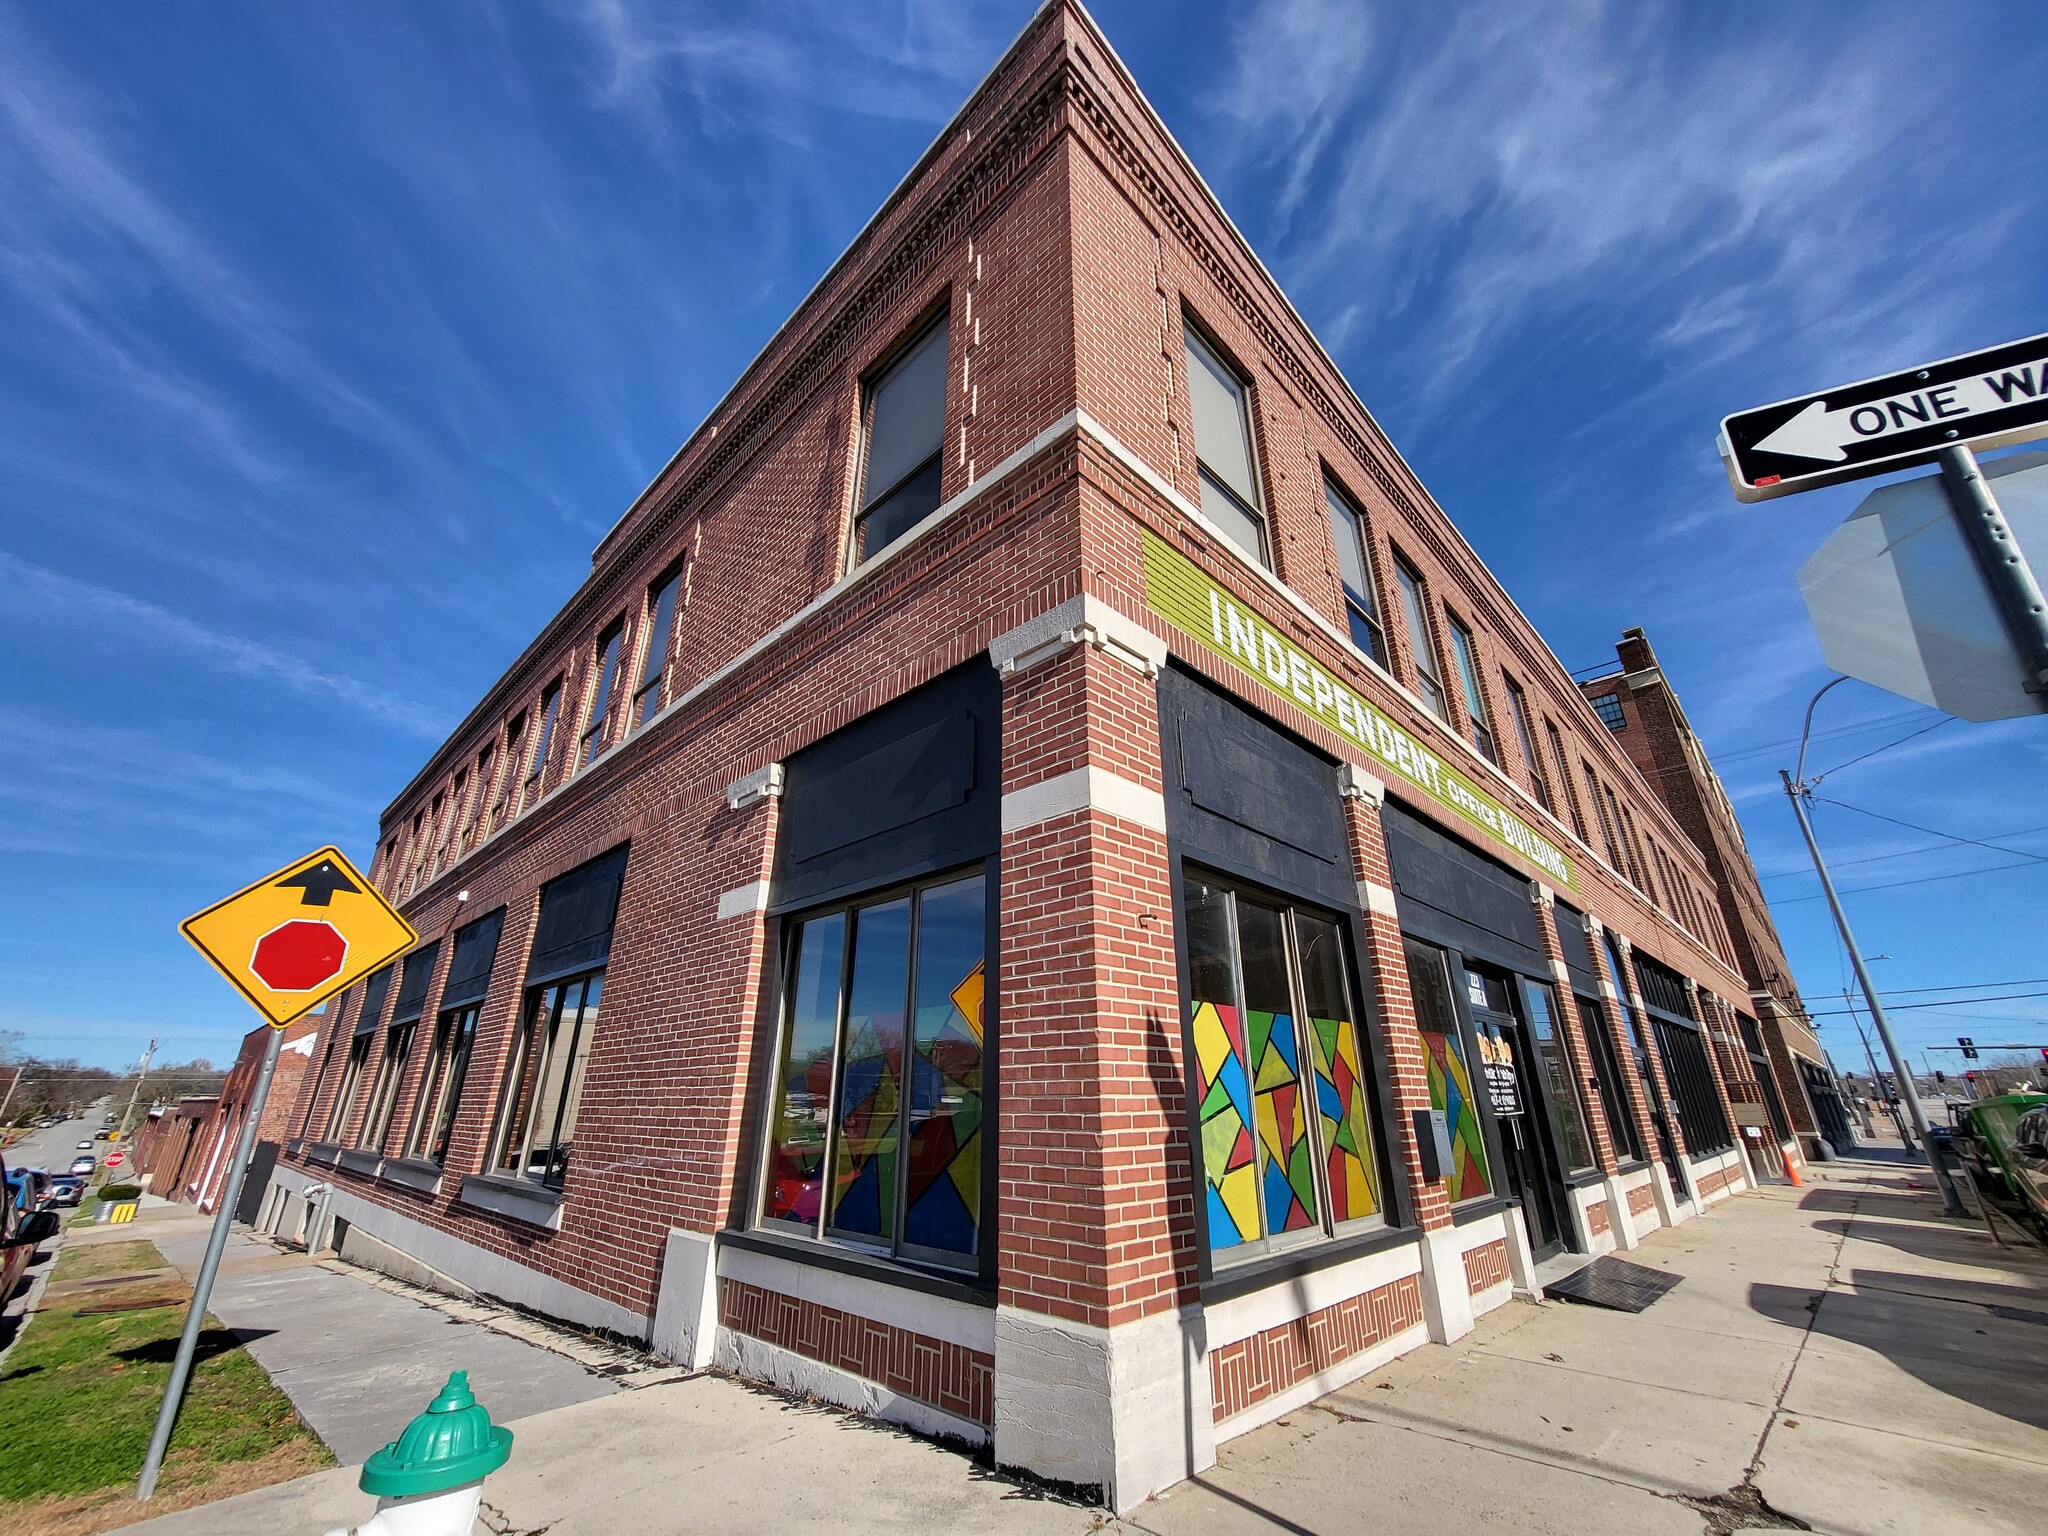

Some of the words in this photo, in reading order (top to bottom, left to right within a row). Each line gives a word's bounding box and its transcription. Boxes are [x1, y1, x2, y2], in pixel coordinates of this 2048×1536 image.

[1850, 385, 1970, 436] ONE
[1982, 362, 2048, 403] W
[1209, 588, 1442, 795] INDEPENDENT
[1447, 779, 1500, 832] OFFICE
[1498, 807, 1568, 884] BUILDING
